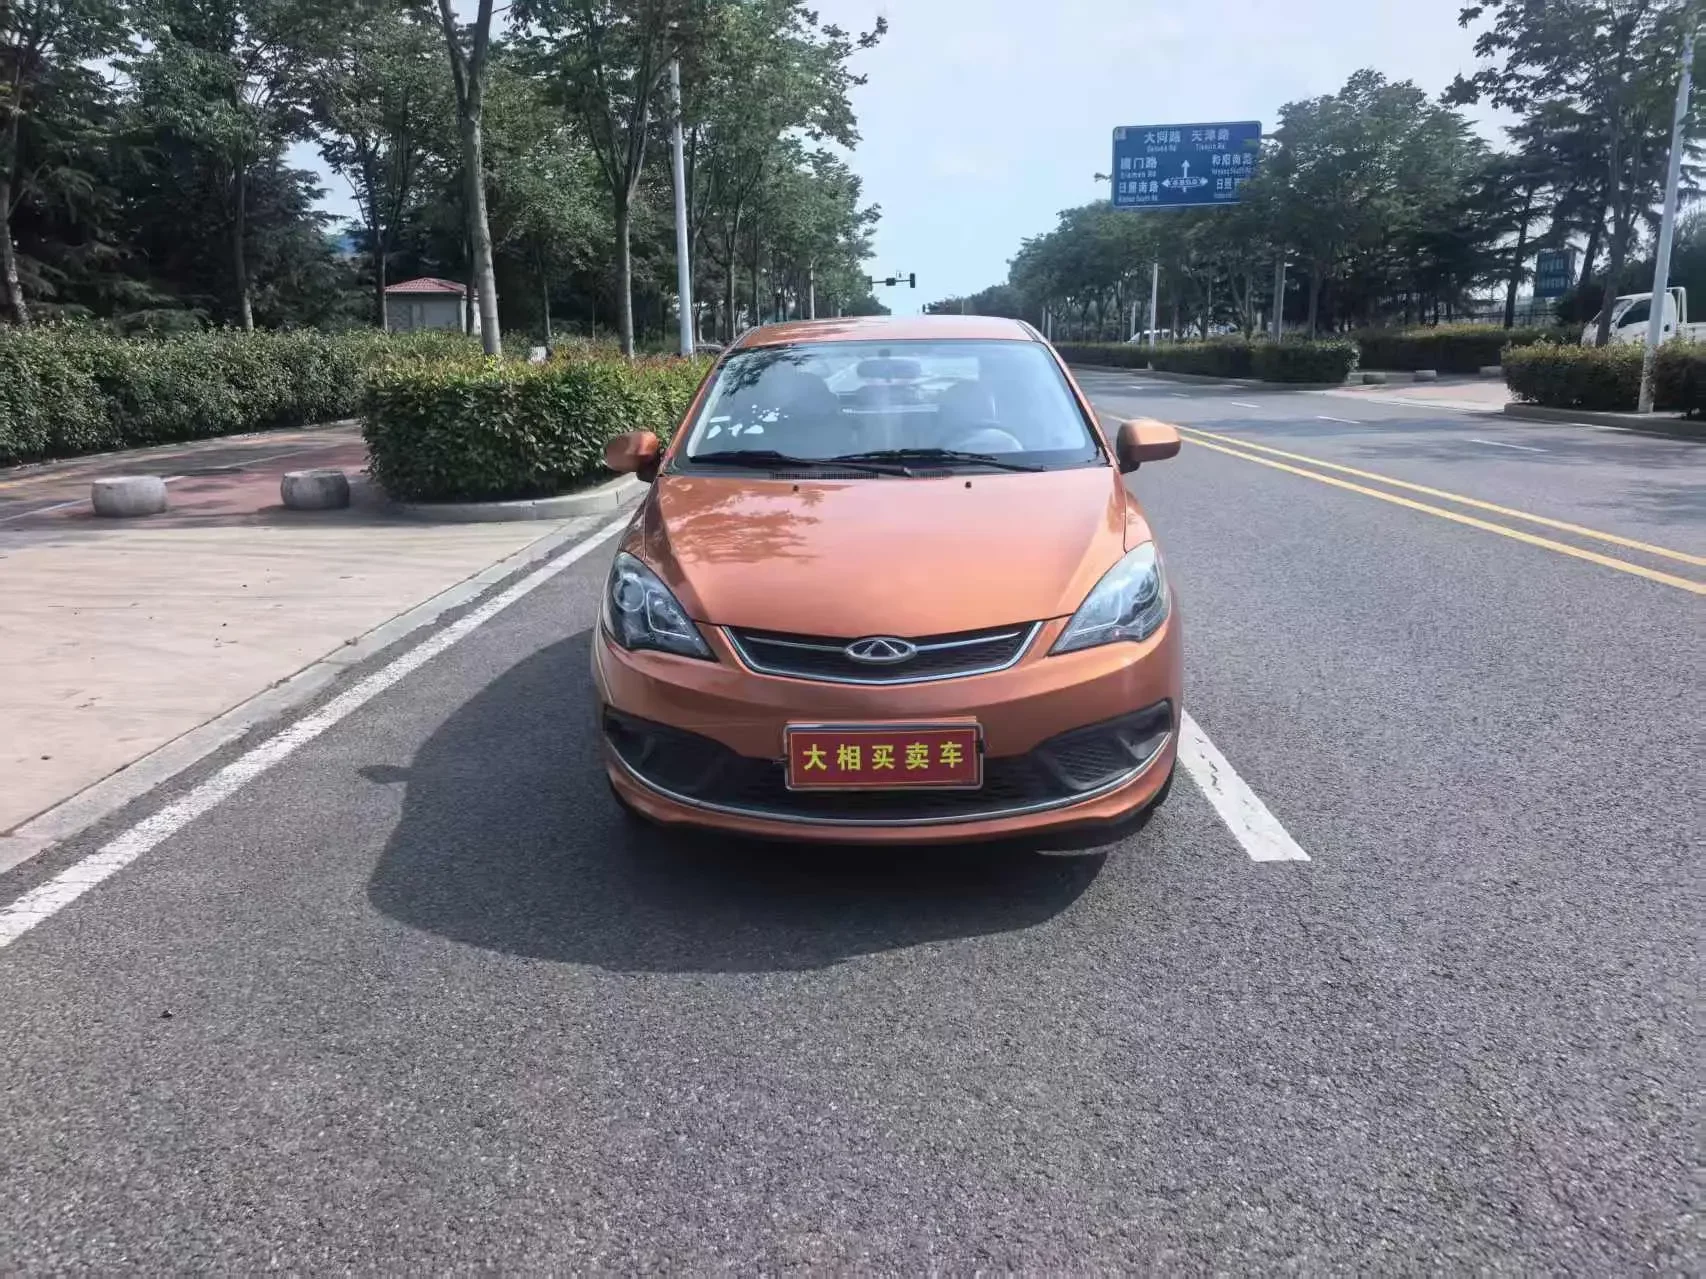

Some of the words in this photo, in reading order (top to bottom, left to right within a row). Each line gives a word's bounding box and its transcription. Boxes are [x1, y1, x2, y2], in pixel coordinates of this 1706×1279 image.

[803, 741, 964, 771] 大相买卖车
